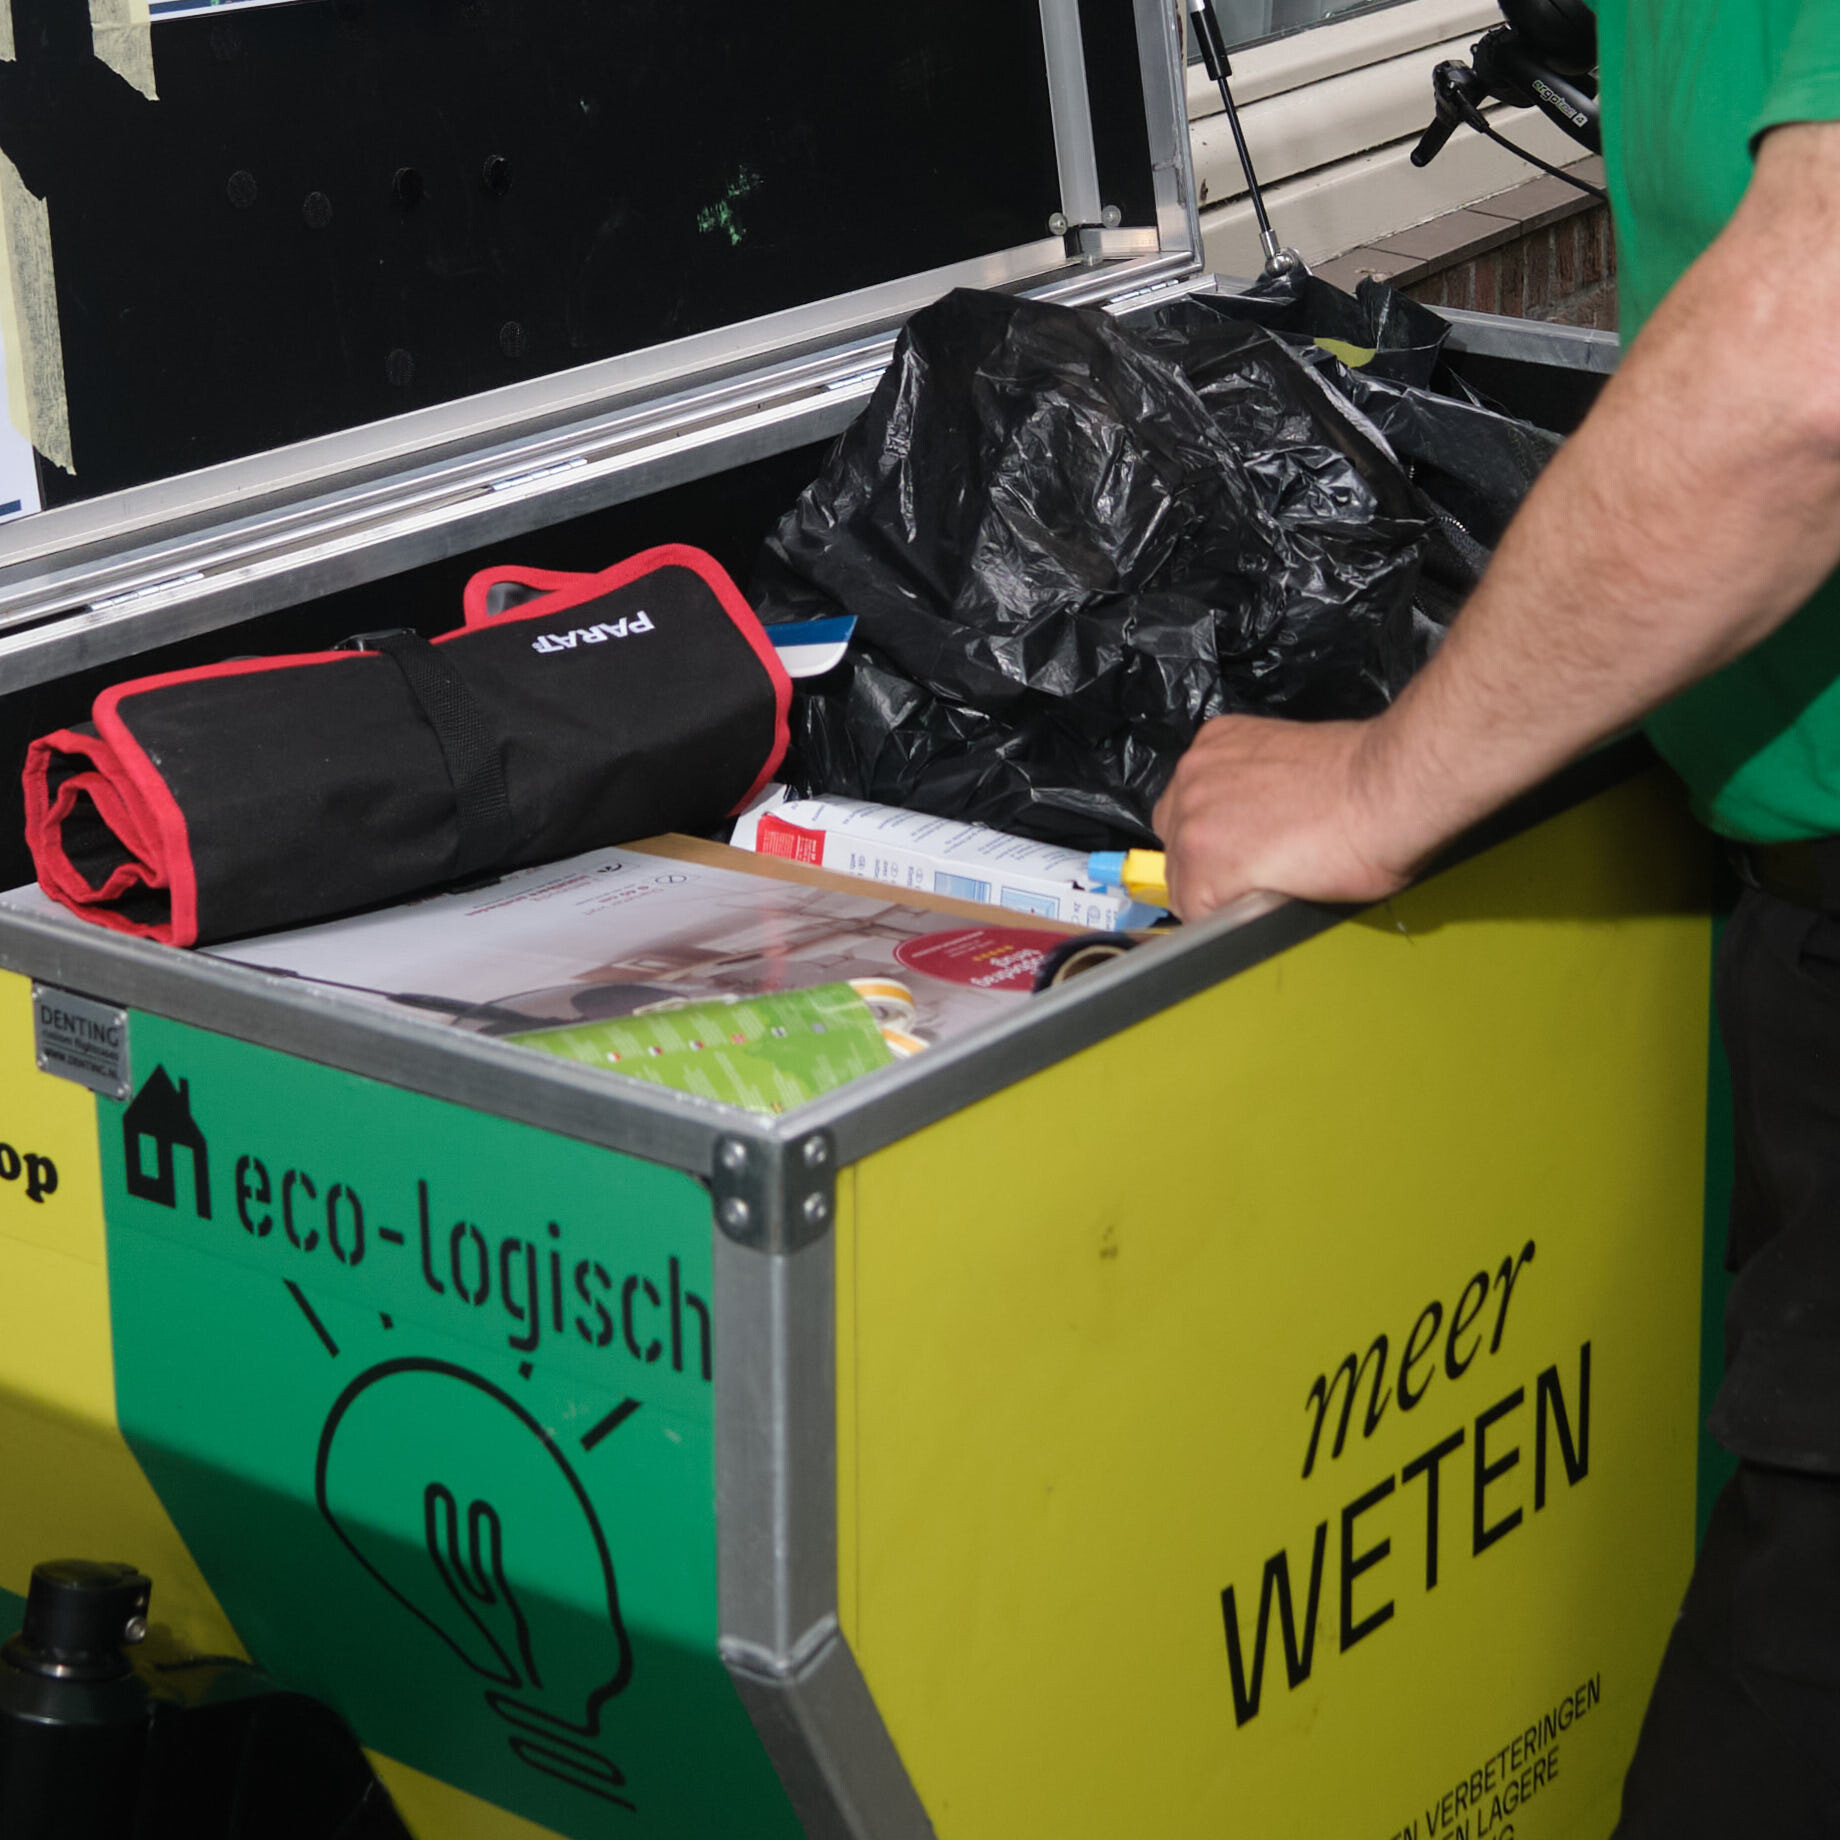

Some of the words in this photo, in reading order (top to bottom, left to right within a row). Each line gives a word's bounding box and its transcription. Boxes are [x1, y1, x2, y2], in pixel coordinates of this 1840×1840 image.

[536, 610, 655, 654] PARAT
[41, 1005, 120, 1047] DENTING
[236, 1153, 714, 1385] eco-logisch
[1302, 1240, 1535, 1480] meer
[1220, 1341, 1592, 1729] WETEN
[1425, 1671, 1601, 1838] VERBETERINGEN
[1477, 1745, 1559, 1838] LAGERE
